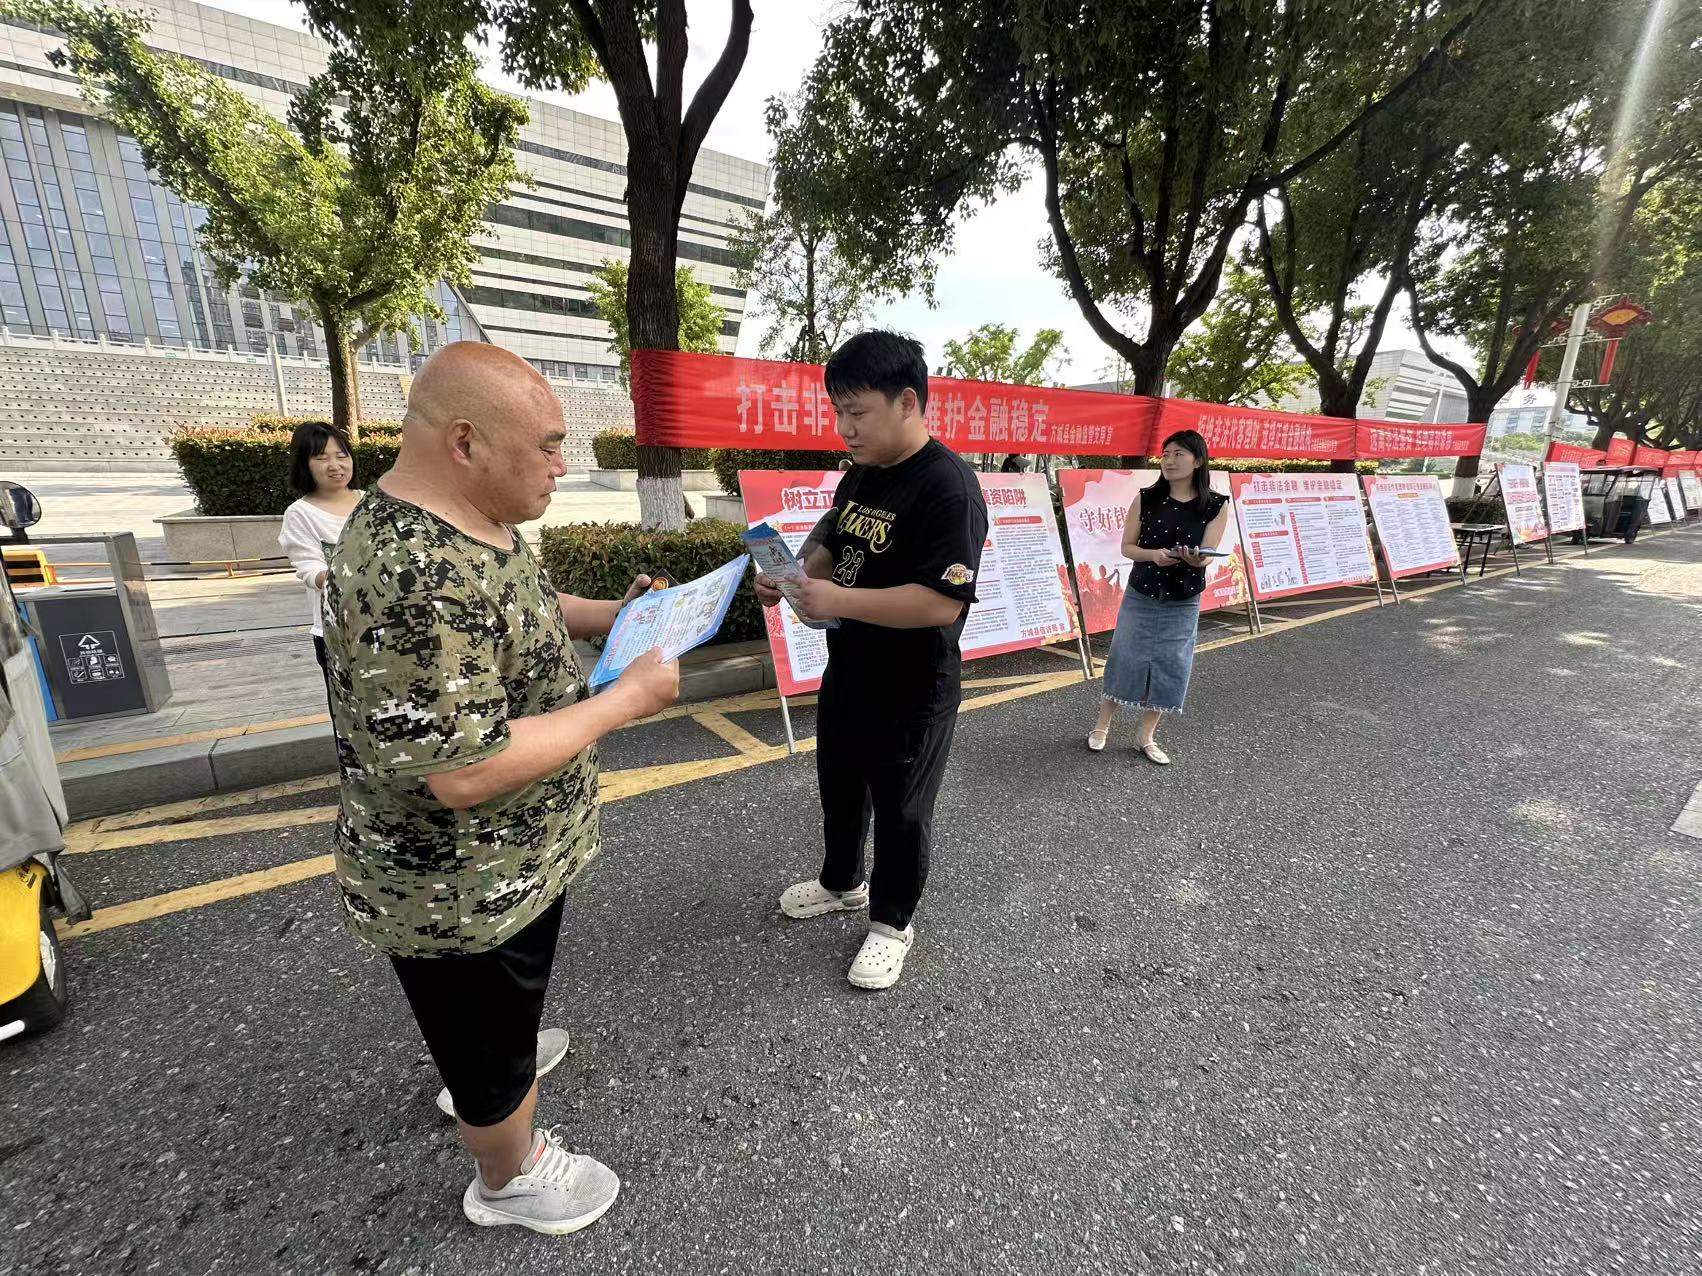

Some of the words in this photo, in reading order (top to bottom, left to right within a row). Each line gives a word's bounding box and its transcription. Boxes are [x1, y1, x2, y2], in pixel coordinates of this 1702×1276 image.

[925, 392, 1048, 442] 维护金融稳定
[836, 500, 893, 553] LAKERS
[858, 505, 871, 514] LOS
[832, 545, 865, 587] 23
